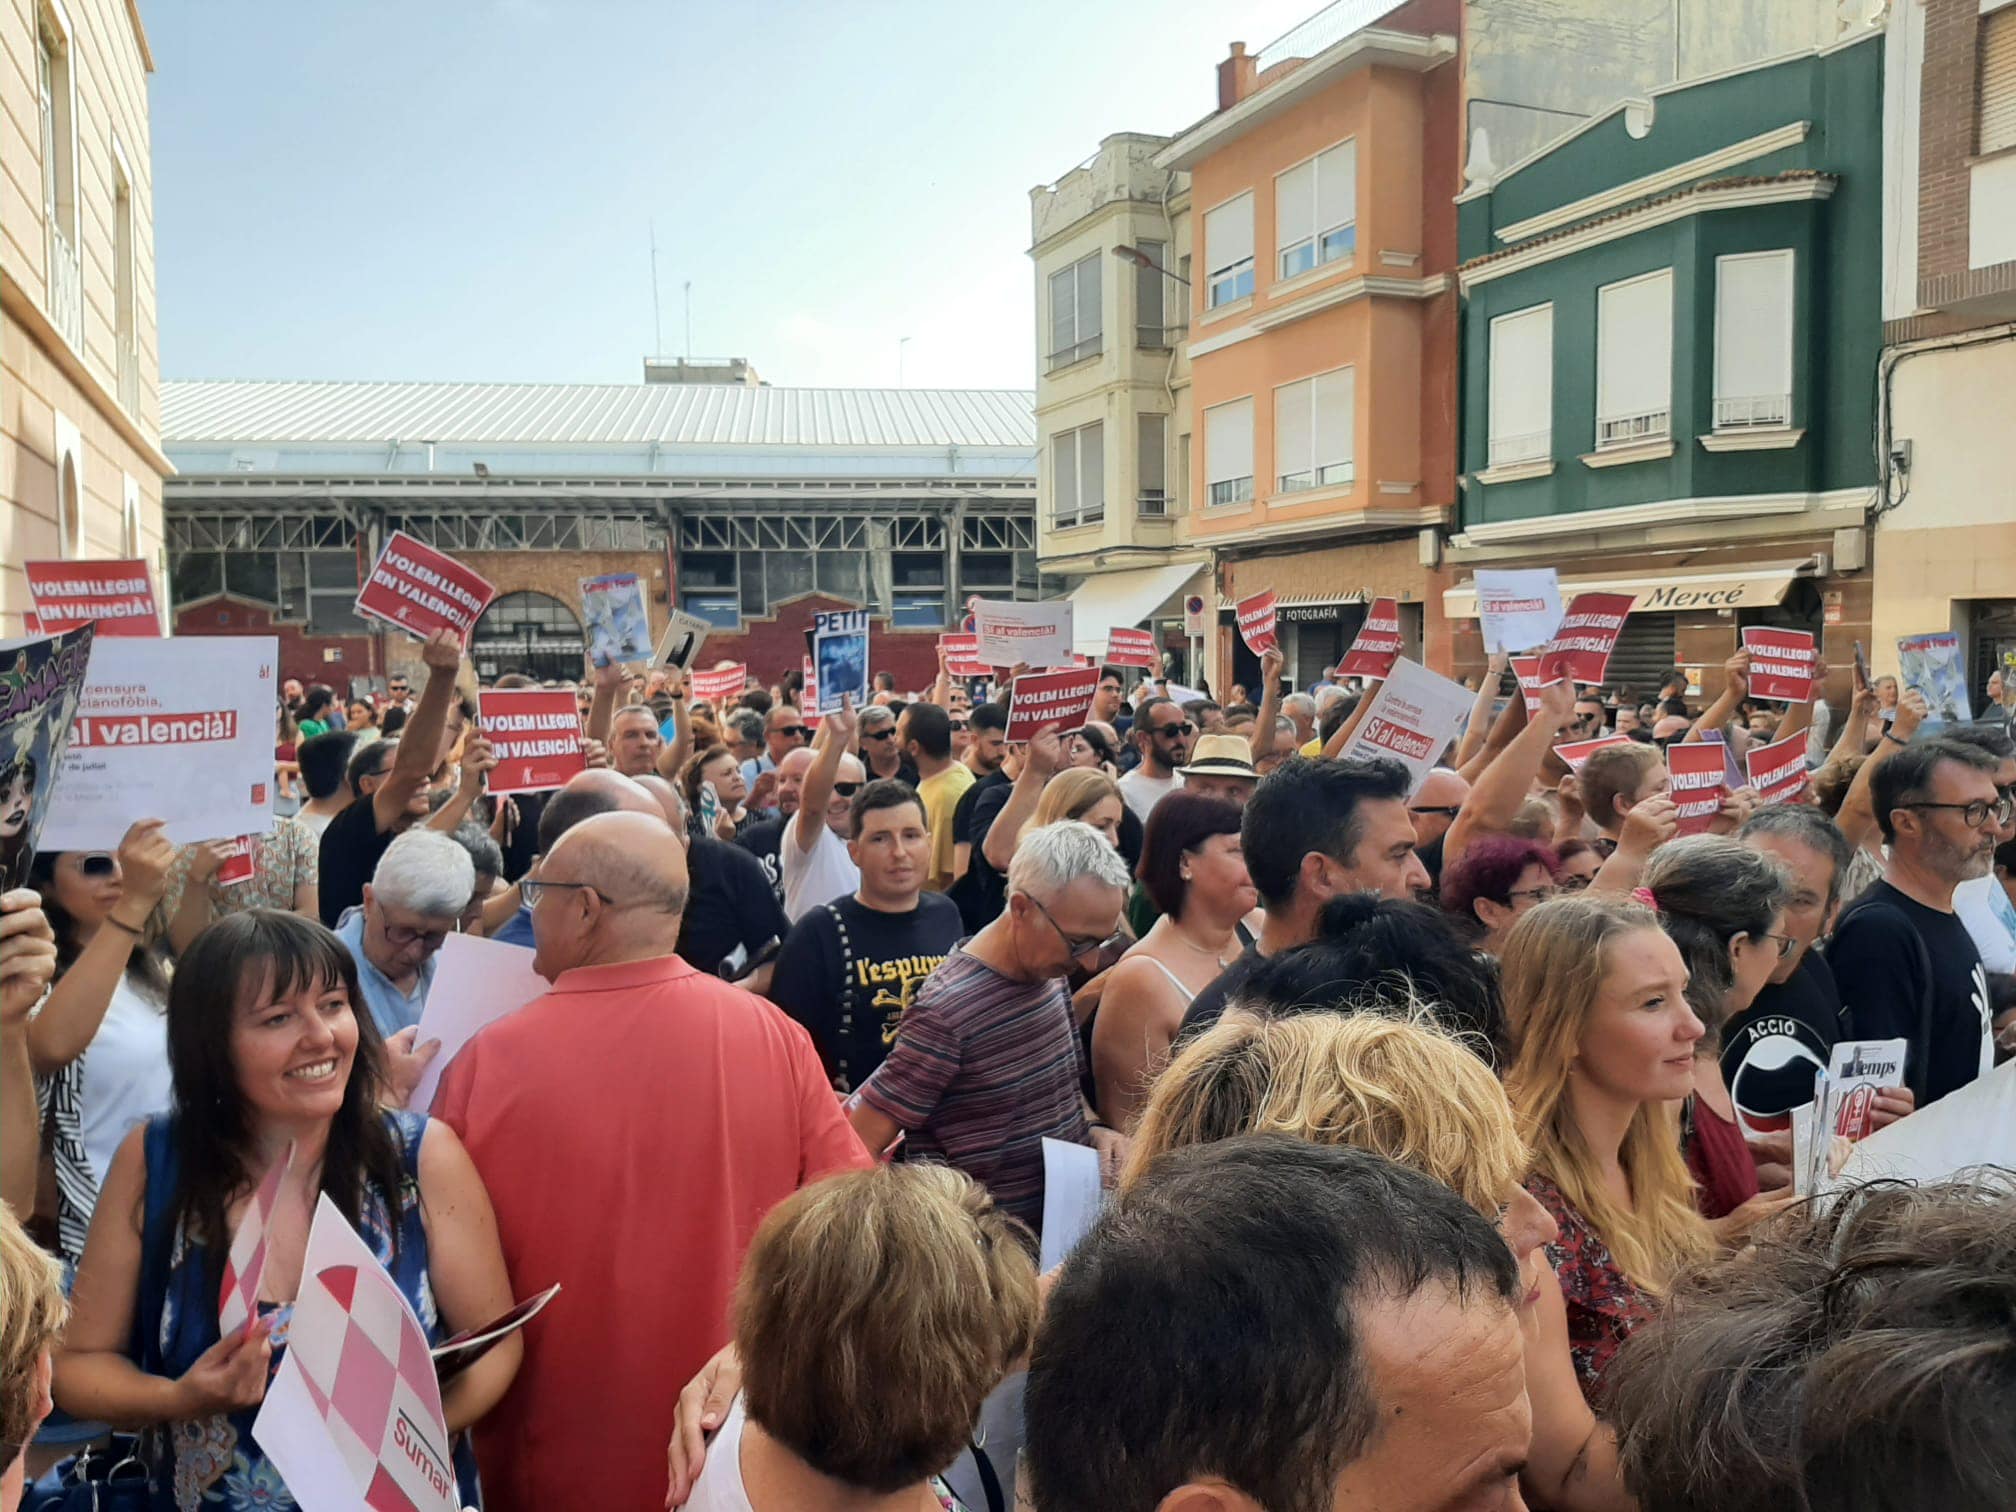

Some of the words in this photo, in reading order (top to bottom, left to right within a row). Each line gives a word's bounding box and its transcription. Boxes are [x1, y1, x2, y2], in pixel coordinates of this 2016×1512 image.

[31, 579, 89, 597] VOLEM
[90, 578, 147, 596] LLEGIR
[385, 550, 441, 587] VOLEM
[440, 578, 482, 613] LLEGIR
[373, 570, 398, 590] EN
[396, 581, 472, 632] VALENCIÀ!
[1644, 583, 1745, 607] Mercé
[39, 604, 62, 620] EN
[64, 597, 154, 619] VALENCIÀ!
[815, 610, 868, 634] PETIT
[1587, 613, 1622, 629] LLEGIR
[1747, 644, 1780, 658] VOLEM
[1782, 648, 1811, 661] LLEGIR
[1749, 662, 1763, 674] EN
[1014, 689, 1057, 705] VOLEM
[1059, 683, 1095, 700] LLEGIR
[483, 714, 536, 732] VOLEM
[537, 712, 578, 730] LLEGIR
[1012, 711, 1029, 722] EN
[100, 712, 232, 745] valencià!
[1671, 772, 1700, 790] VOLEM
[1752, 767, 1784, 790] VOLEM
[394, 1417, 450, 1499] Sumar
